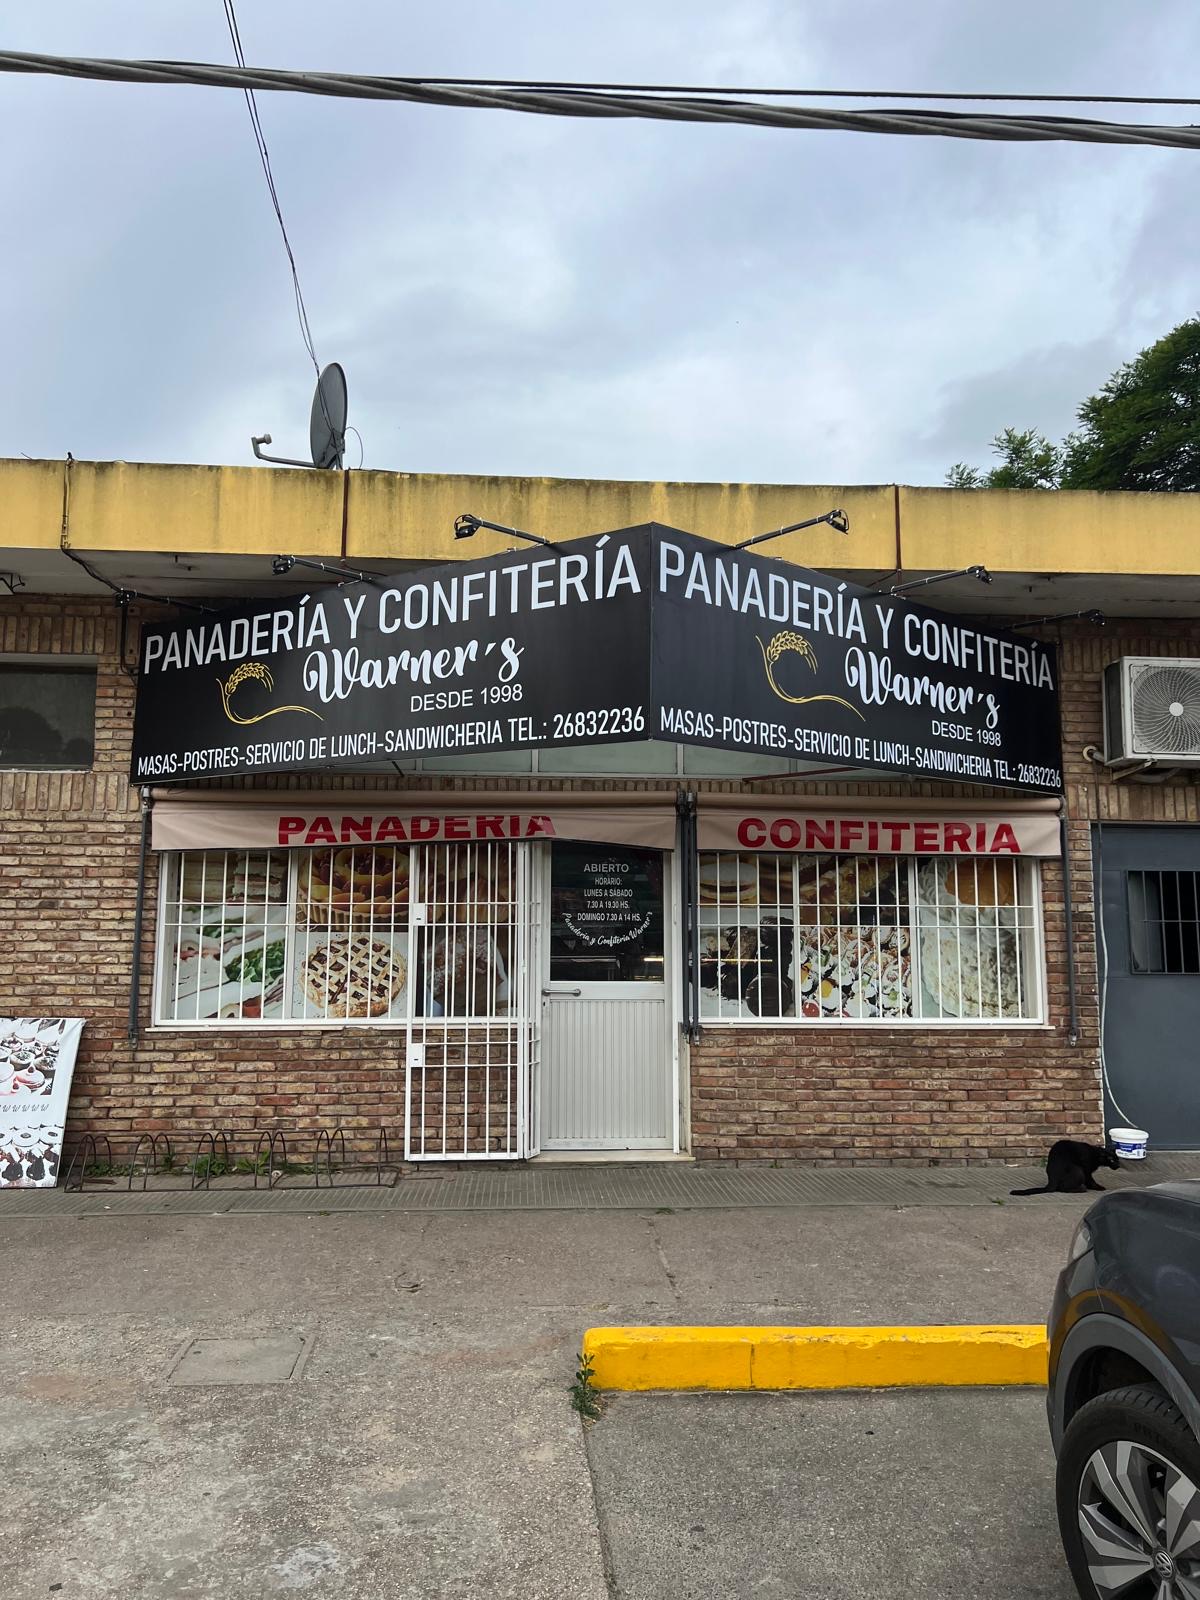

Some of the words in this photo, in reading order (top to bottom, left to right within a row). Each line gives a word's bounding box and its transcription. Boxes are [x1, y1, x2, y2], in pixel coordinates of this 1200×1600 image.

[144, 594, 331, 674] PANADERÍA
[343, 594, 367, 639] Y
[378, 534, 642, 634] CONFITERÍA
[659, 540, 868, 644] PANADERÍA
[875, 604, 895, 649] Y
[903, 613, 1054, 691] CONFITERÍA
[410, 689, 474, 713] DESDE
[480, 683, 523, 705] 1998
[309, 737, 327, 760] DE
[508, 717, 547, 742] TEL.:
[553, 705, 645, 739] 26832236
[931, 719, 974, 742] DESDE
[976, 728, 1002, 747] 1998
[855, 736, 870, 761] DE
[1017, 763, 1062, 788] 26832236
[278, 815, 556, 845] PANADERIA
[737, 817, 1022, 854] CONFITERIA
[583, 863, 629, 873] ABIERTO
[583, 889, 603, 897] LUNES
[603, 889, 608, 897] A
[587, 901, 599, 909] 7.30
[605, 901, 619, 909] 19.30
[620, 901, 630, 909] HS.
[577, 913, 605, 921] DOMINGO
[606, 913, 618, 921] 7.30
[618, 913, 623, 921] A
[624, 913, 631, 921] 14
[631, 913, 642, 922] HS.
[589, 937, 596, 946] y
